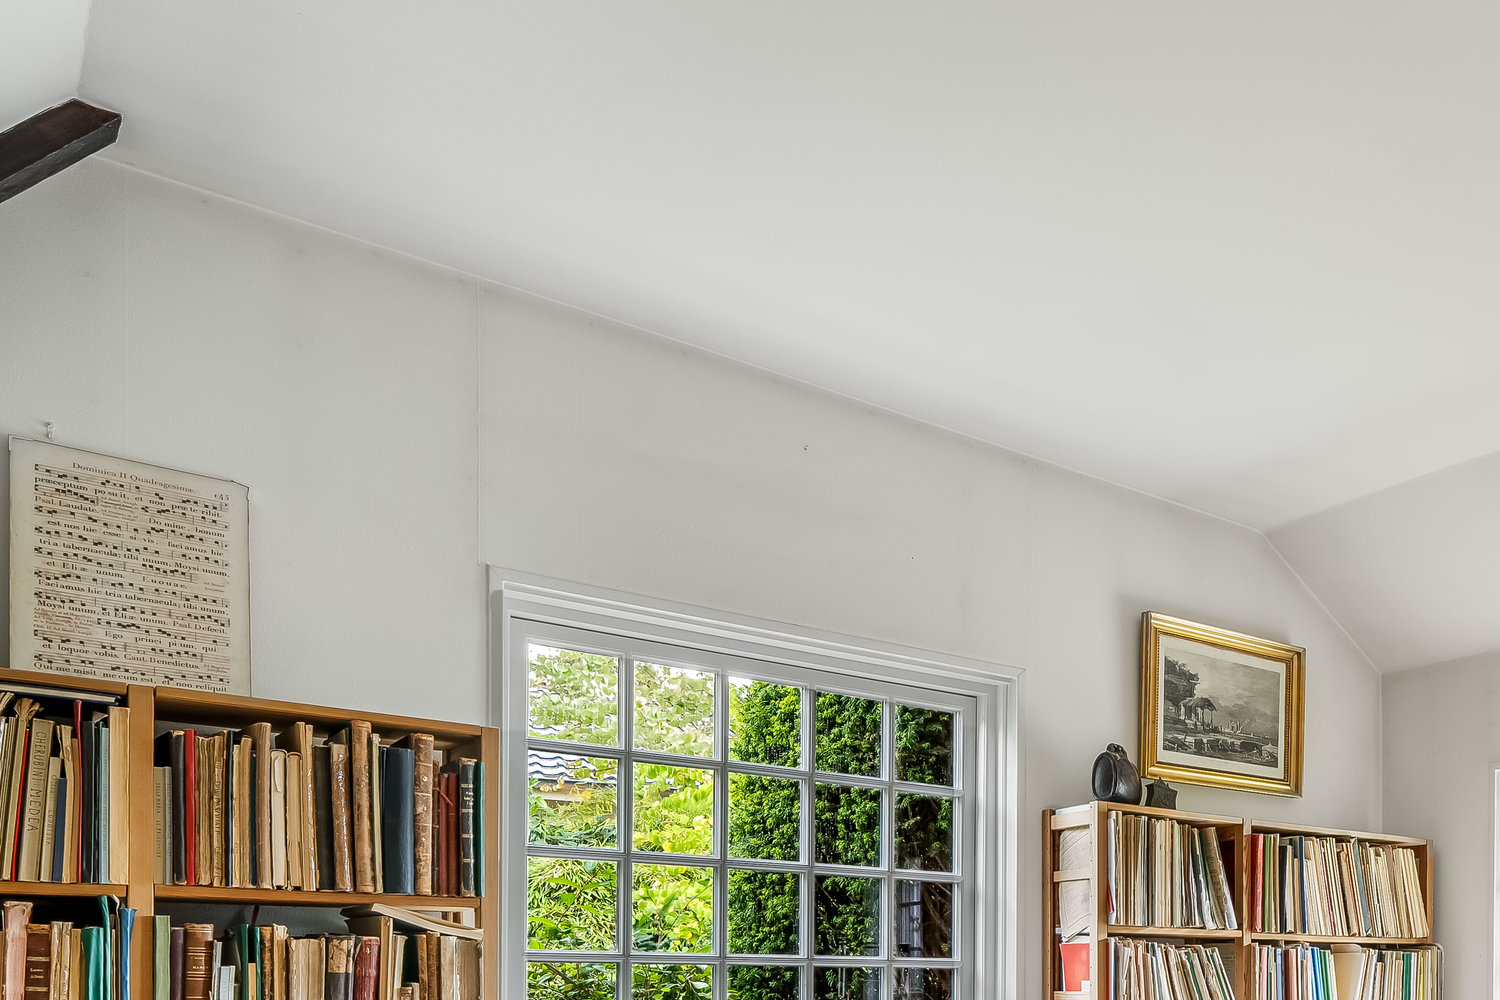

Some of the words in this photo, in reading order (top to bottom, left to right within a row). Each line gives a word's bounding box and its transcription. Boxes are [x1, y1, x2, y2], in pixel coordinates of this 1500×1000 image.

[72, 463, 116, 477] Dominica
[195, 527, 225, 538] bonum
[174, 562, 199, 574] Moysi
[38, 579, 85, 592] Faciamus
[38, 600, 65, 610] Moysi
[105, 631, 123, 639] Ego
[58, 644, 90, 654] loquor
[34, 661, 52, 670] Qui
[73, 667, 96, 676] misit
[196, 683, 226, 693] reliquit
[28, 787, 43, 832] MEDEA
